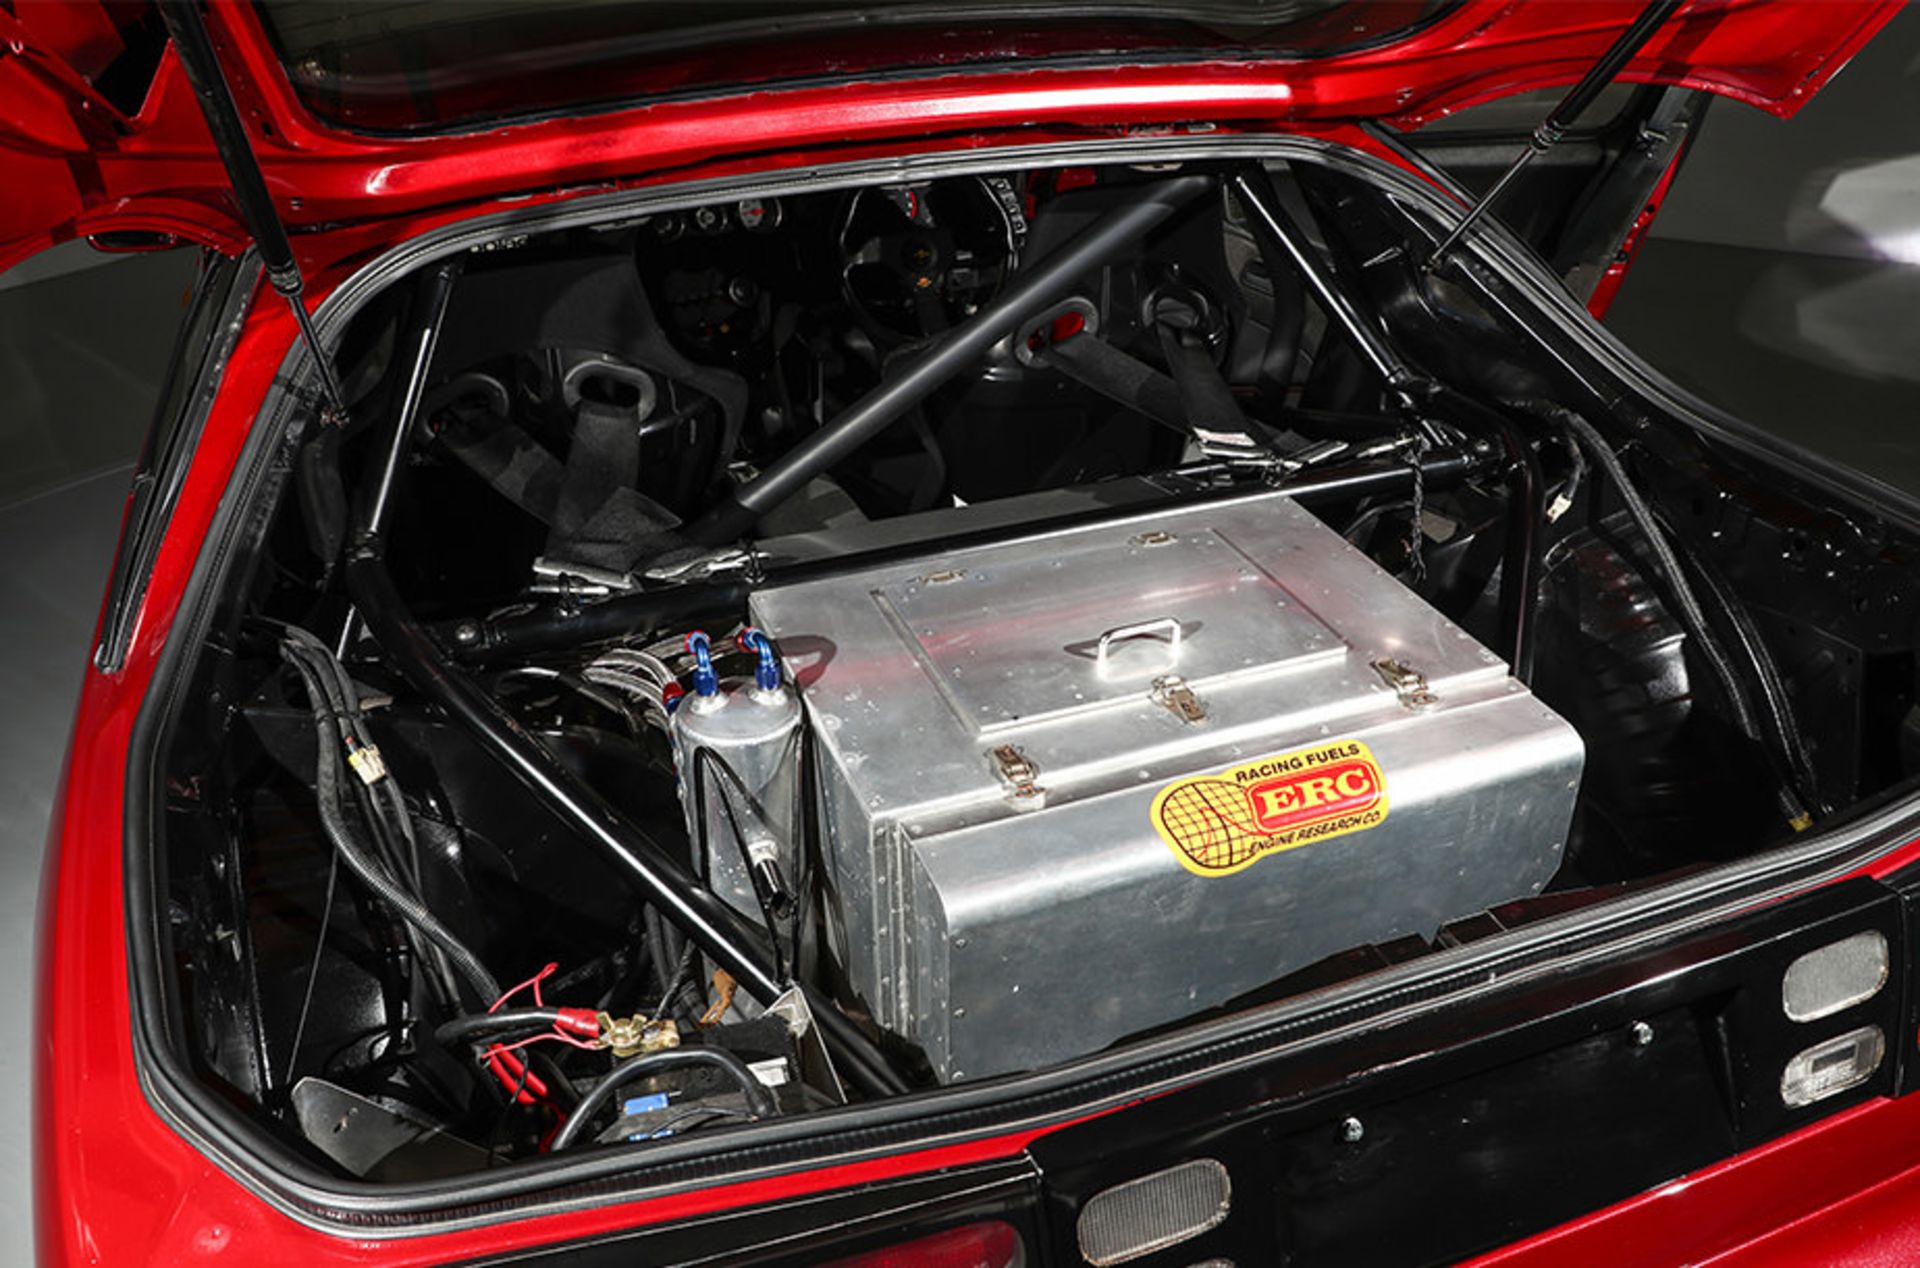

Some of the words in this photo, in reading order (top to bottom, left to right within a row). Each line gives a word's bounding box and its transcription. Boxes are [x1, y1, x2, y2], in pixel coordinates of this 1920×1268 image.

[1235, 757, 1303, 782] RACING
[1306, 744, 1360, 765] FUELS
[1256, 768, 1371, 819] ERC
[1249, 832, 1295, 853] ENGINE
[1296, 815, 1362, 841] RESEARCH
